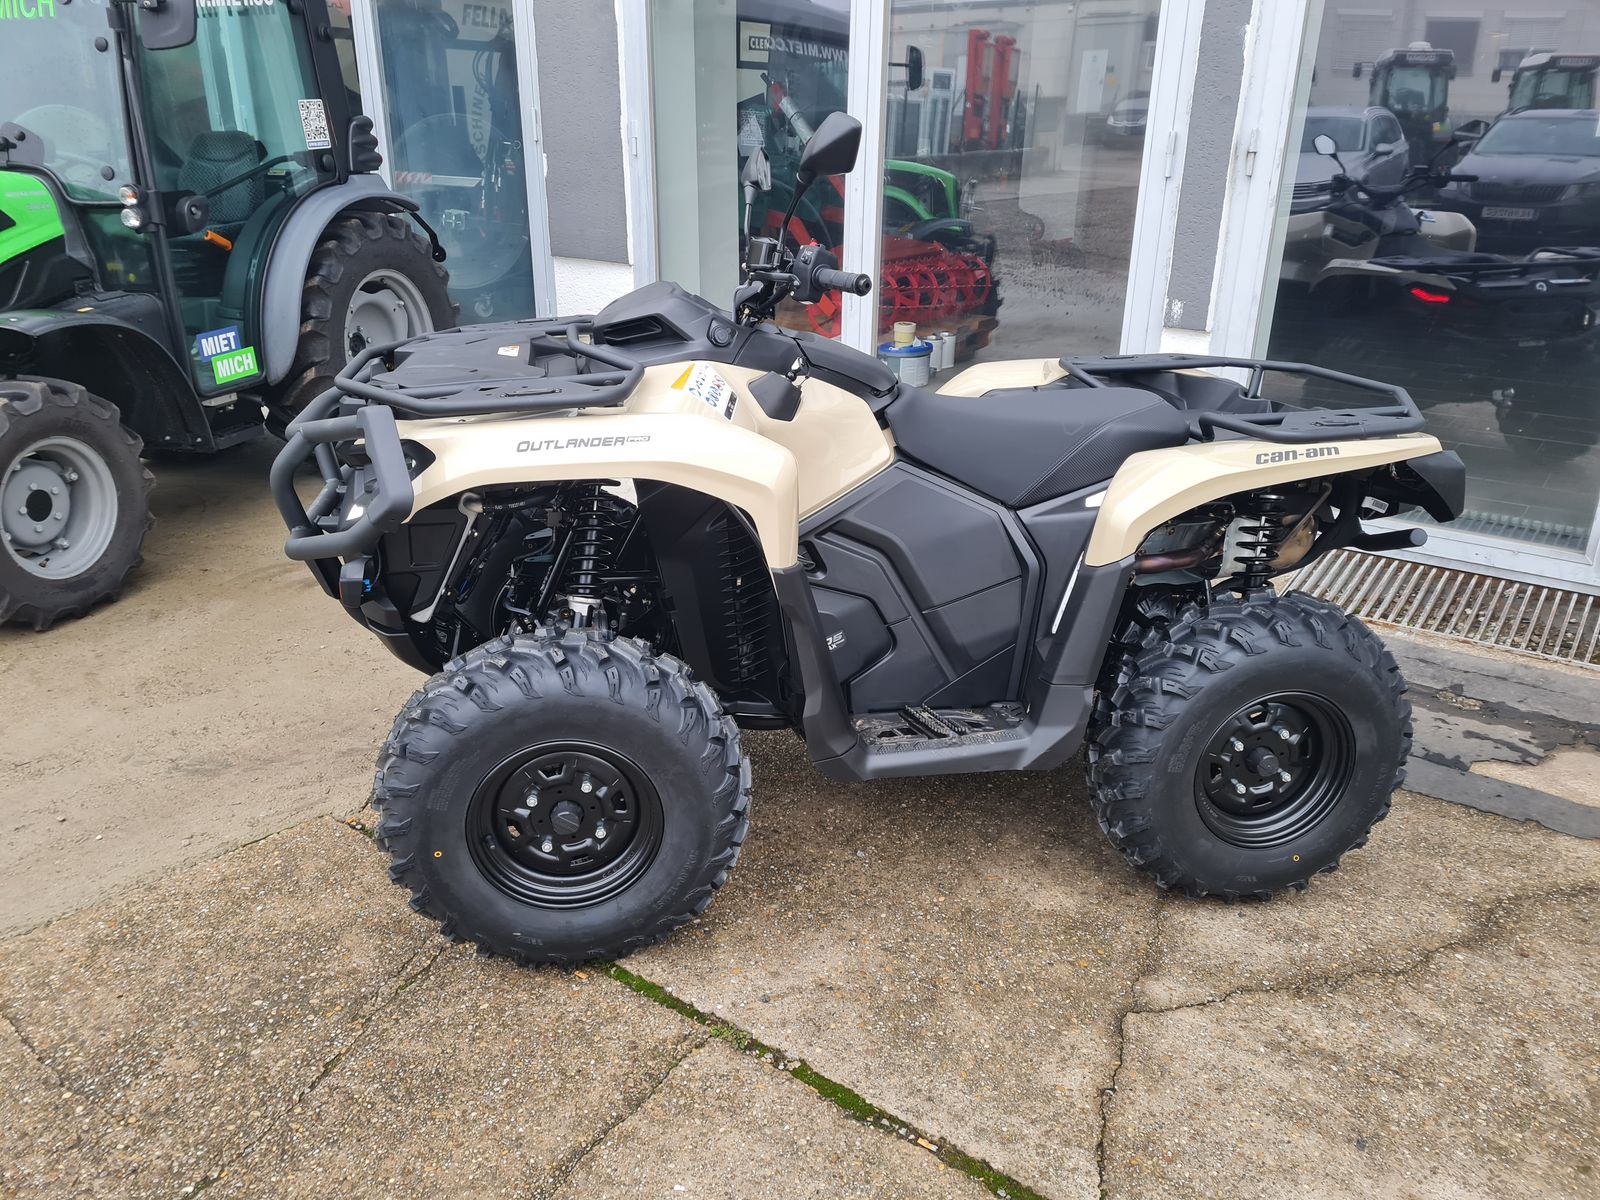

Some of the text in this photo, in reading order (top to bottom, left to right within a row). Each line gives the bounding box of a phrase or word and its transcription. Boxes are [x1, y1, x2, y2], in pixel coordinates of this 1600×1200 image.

[200, 331, 236, 357] MIET
[216, 352, 254, 378] MICH
[516, 437, 626, 453] OUTLANDER
[1255, 446, 1340, 464] can-am
